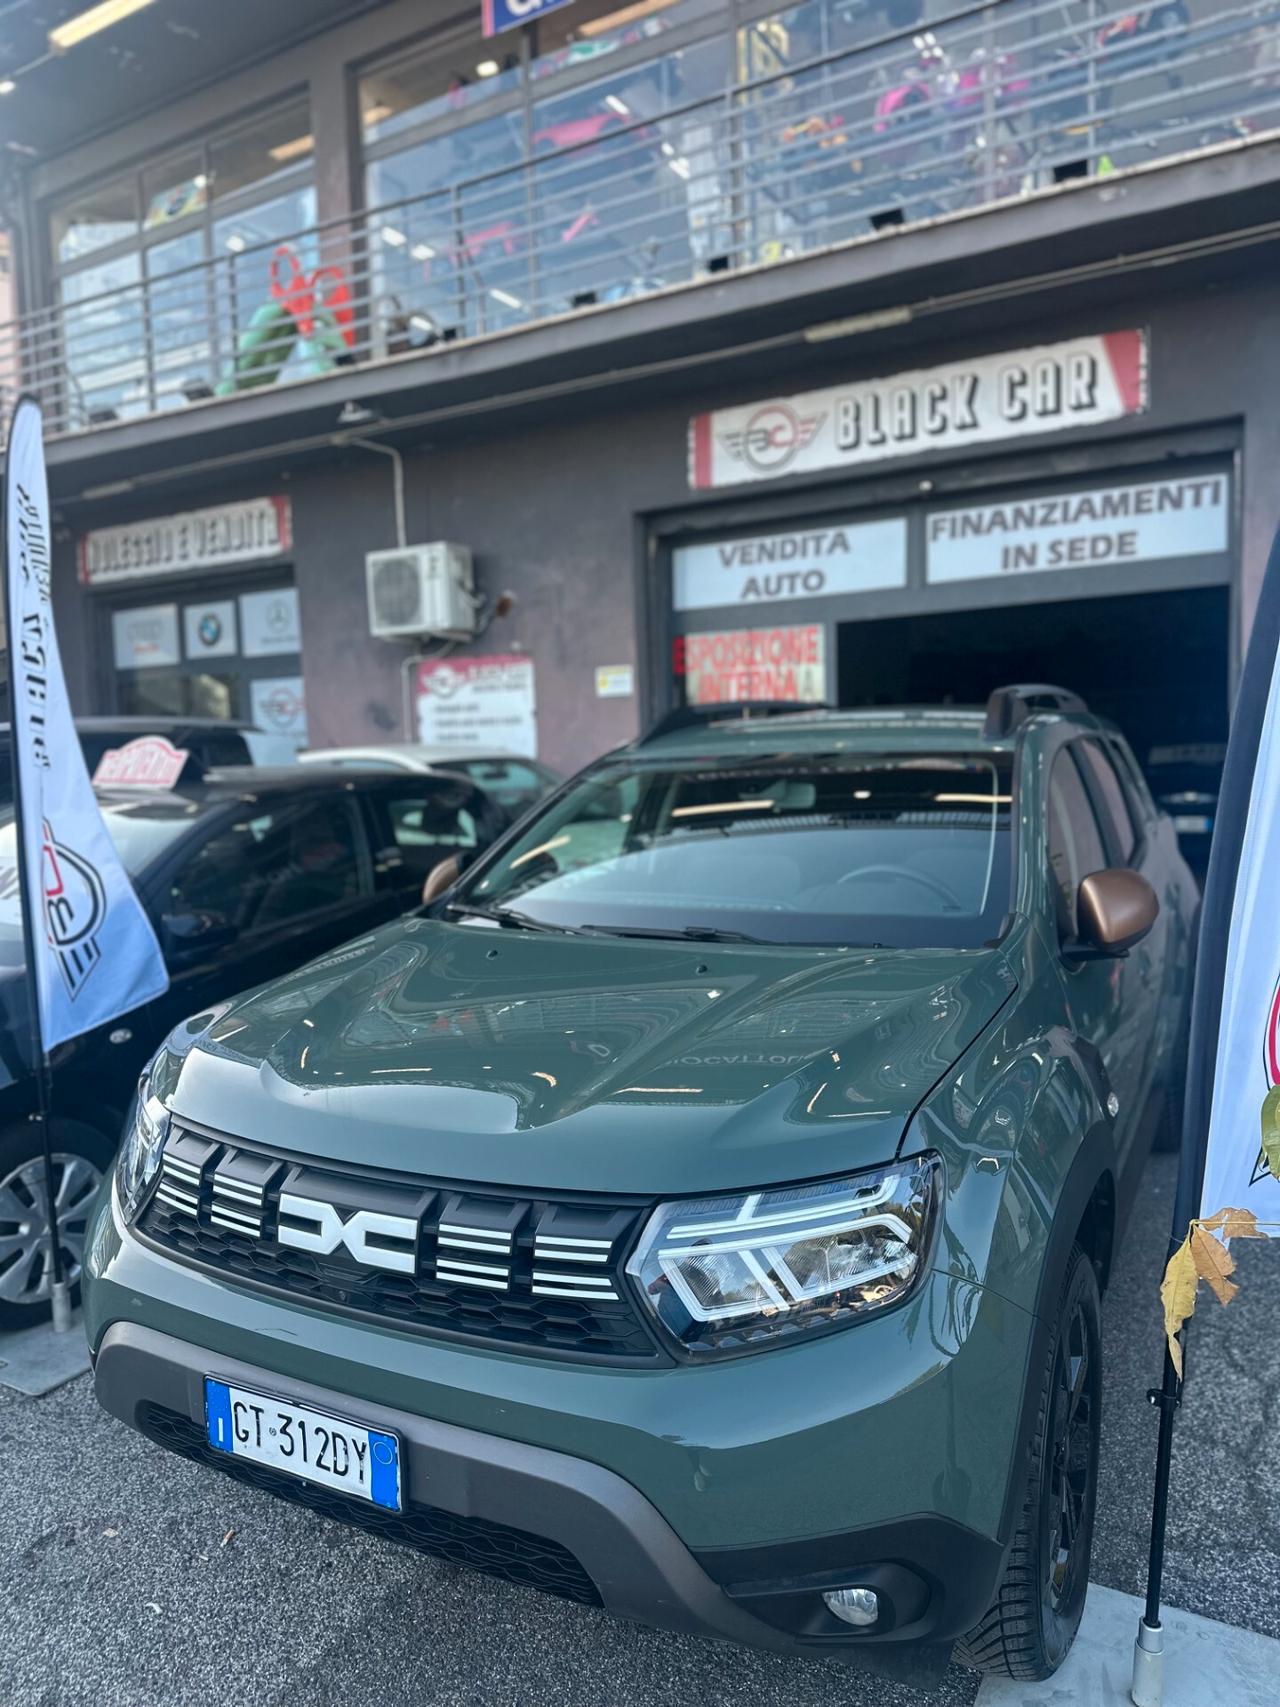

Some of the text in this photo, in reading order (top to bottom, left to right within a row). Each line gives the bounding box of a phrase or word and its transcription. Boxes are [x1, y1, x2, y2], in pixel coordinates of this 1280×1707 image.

[834, 351, 1098, 451] BLACK CAR
[929, 478, 1222, 542] FINANZIAMENTI
[718, 529, 851, 570] VENDITA
[1002, 530, 1139, 570] IN SEDE
[741, 568, 827, 600] AUTO
